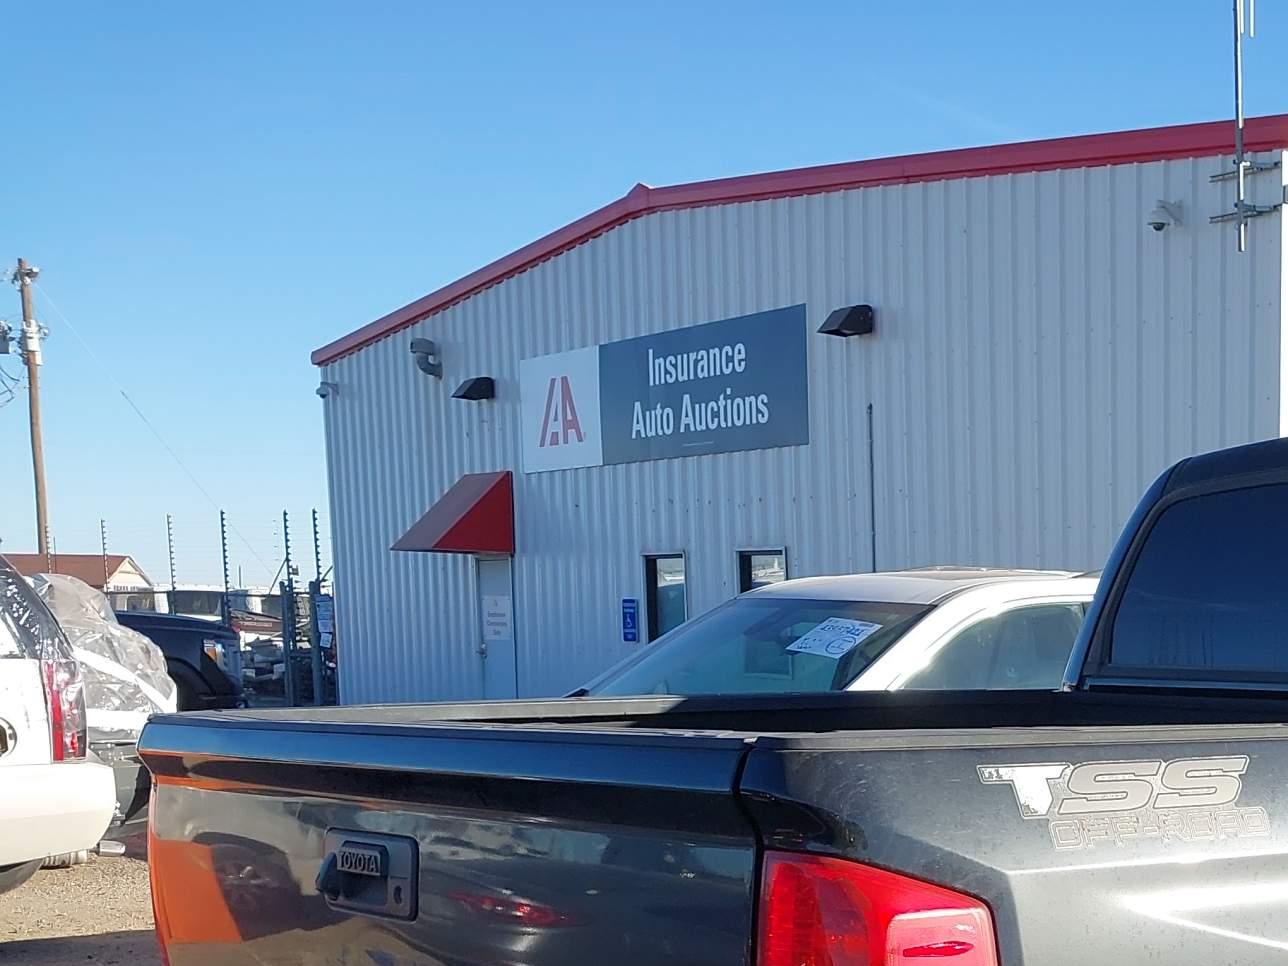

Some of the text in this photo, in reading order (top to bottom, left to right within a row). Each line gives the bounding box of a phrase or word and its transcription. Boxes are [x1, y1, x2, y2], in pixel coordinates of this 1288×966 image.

[648, 342, 746, 386] Insurance
[631, 387, 769, 439] Auto Auctions
[976, 756, 1249, 819] TSS
[1049, 807, 1270, 850] OFF-ROAD
[337, 851, 379, 874] TOYOTA
